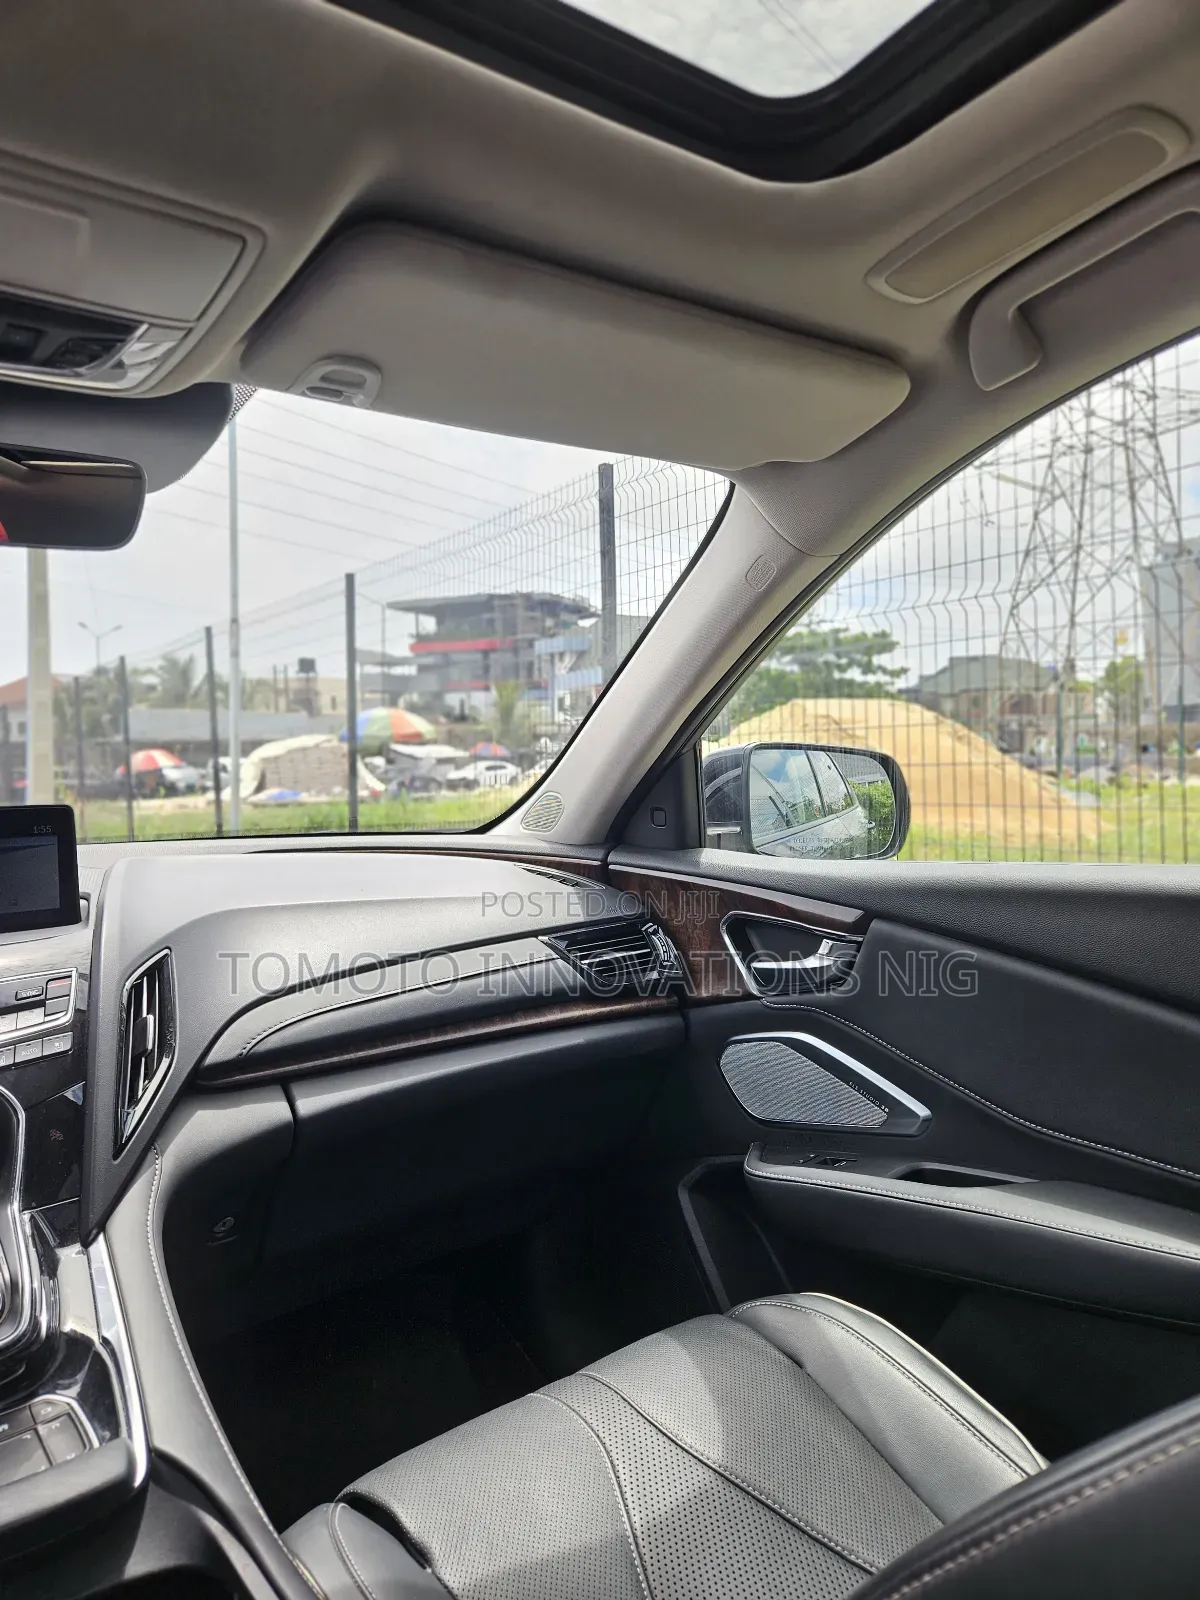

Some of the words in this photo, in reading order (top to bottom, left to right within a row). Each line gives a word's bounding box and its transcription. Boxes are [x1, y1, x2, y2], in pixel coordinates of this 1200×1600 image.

[33, 825, 52, 834] 1:55
[21, 989, 40, 997] SYNC
[21, 1047, 38, 1056] AUTO
[860, 1089, 880, 1105] STUDIO
